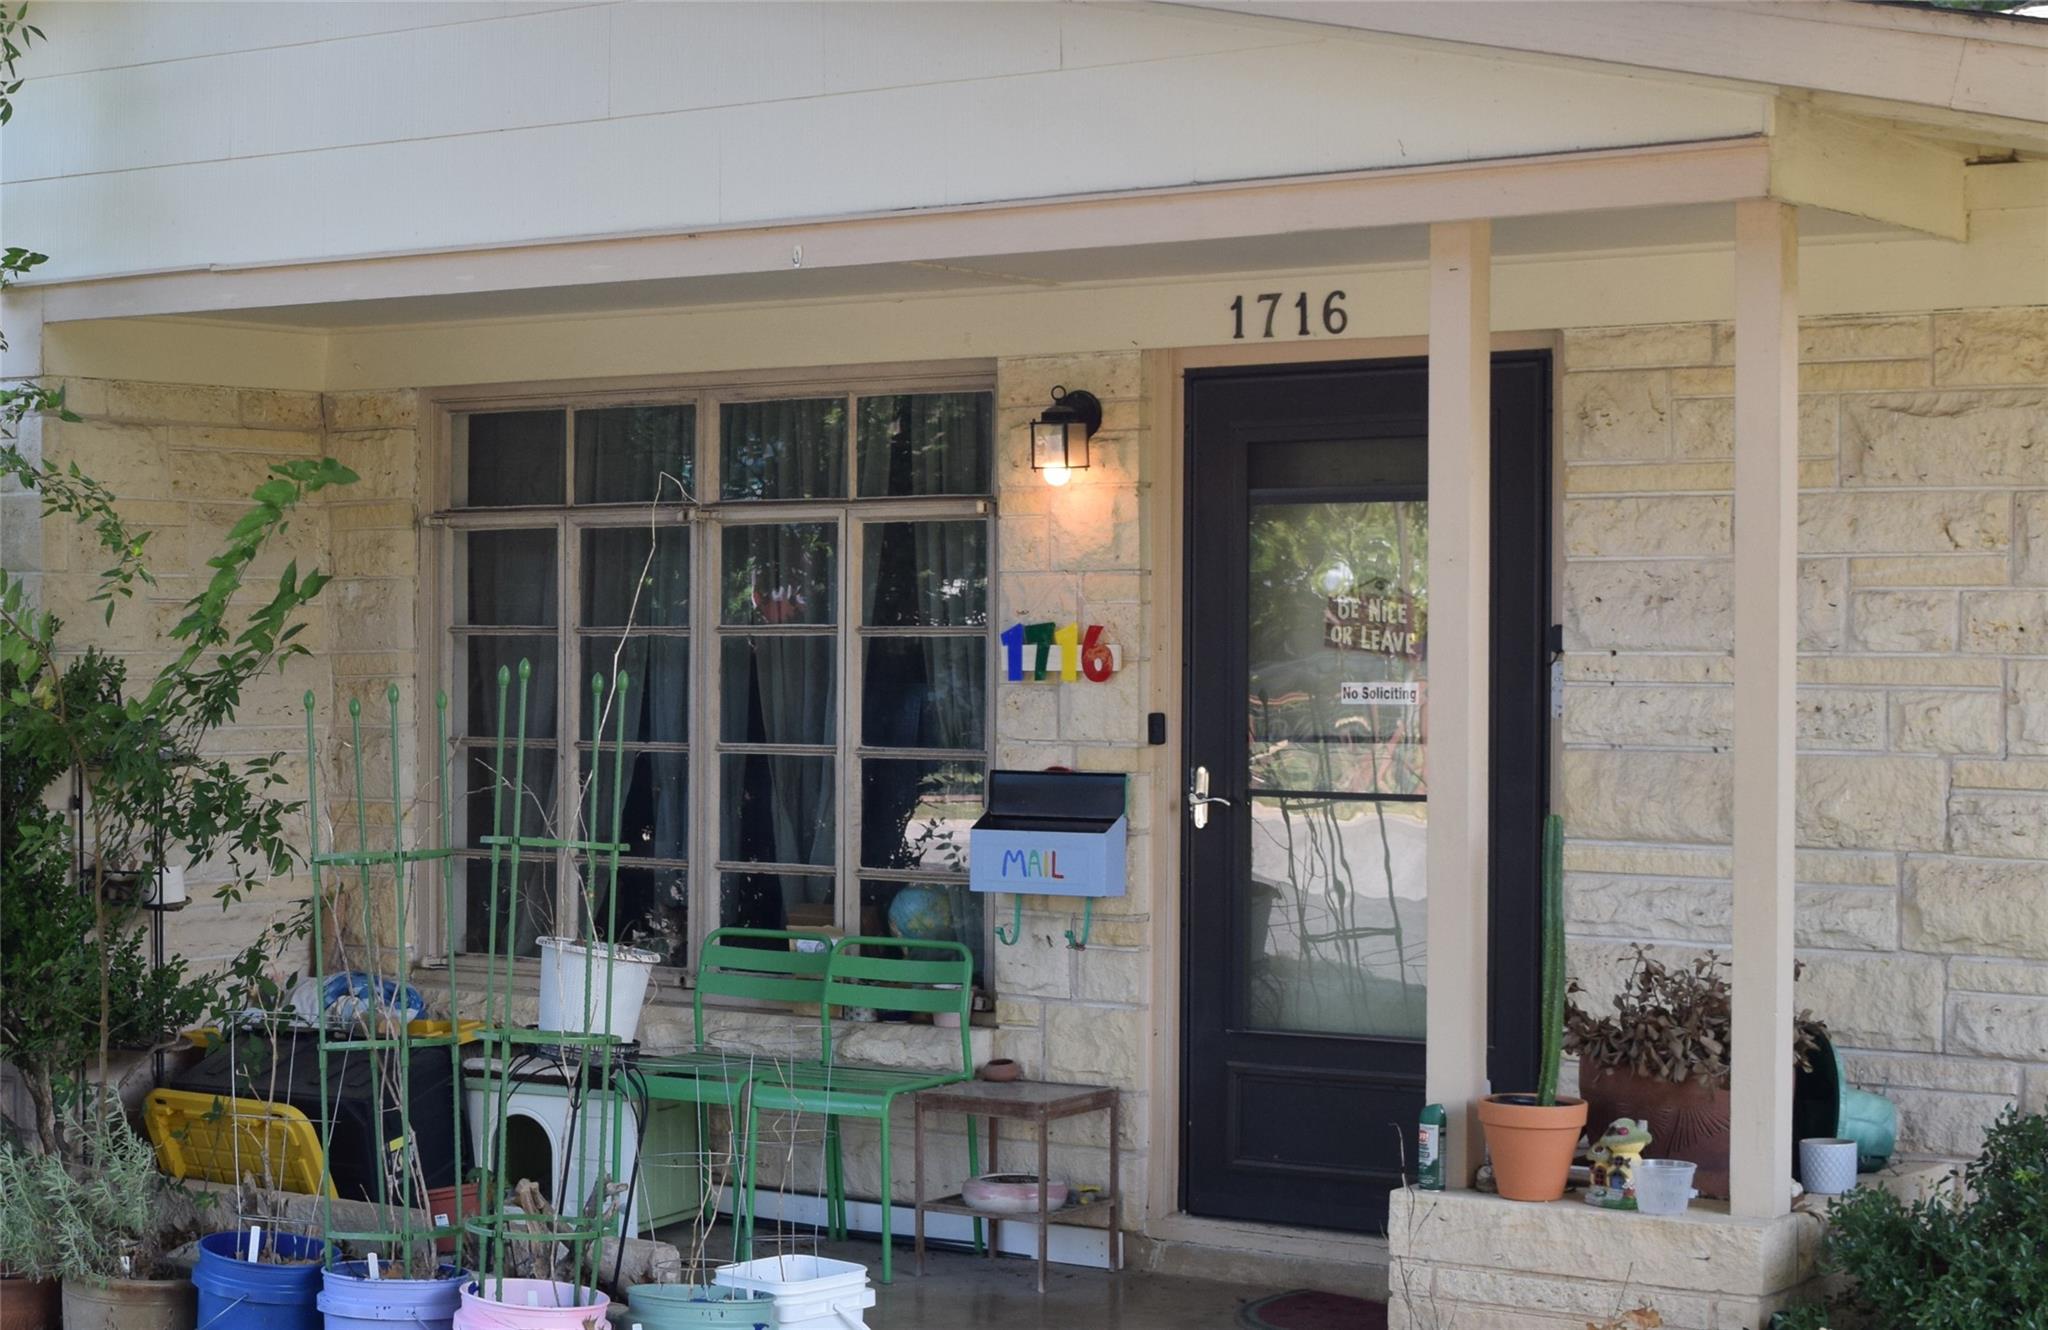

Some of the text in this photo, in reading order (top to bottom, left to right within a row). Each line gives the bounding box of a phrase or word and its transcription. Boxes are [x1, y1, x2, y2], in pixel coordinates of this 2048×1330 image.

[1230, 290, 1348, 339] 1716
[1001, 621, 1114, 683] 1716
[1330, 625, 1416, 655] OR LEAVE
[1343, 686, 1417, 703] No Soliciting
[1002, 849, 1064, 879] MAIL
